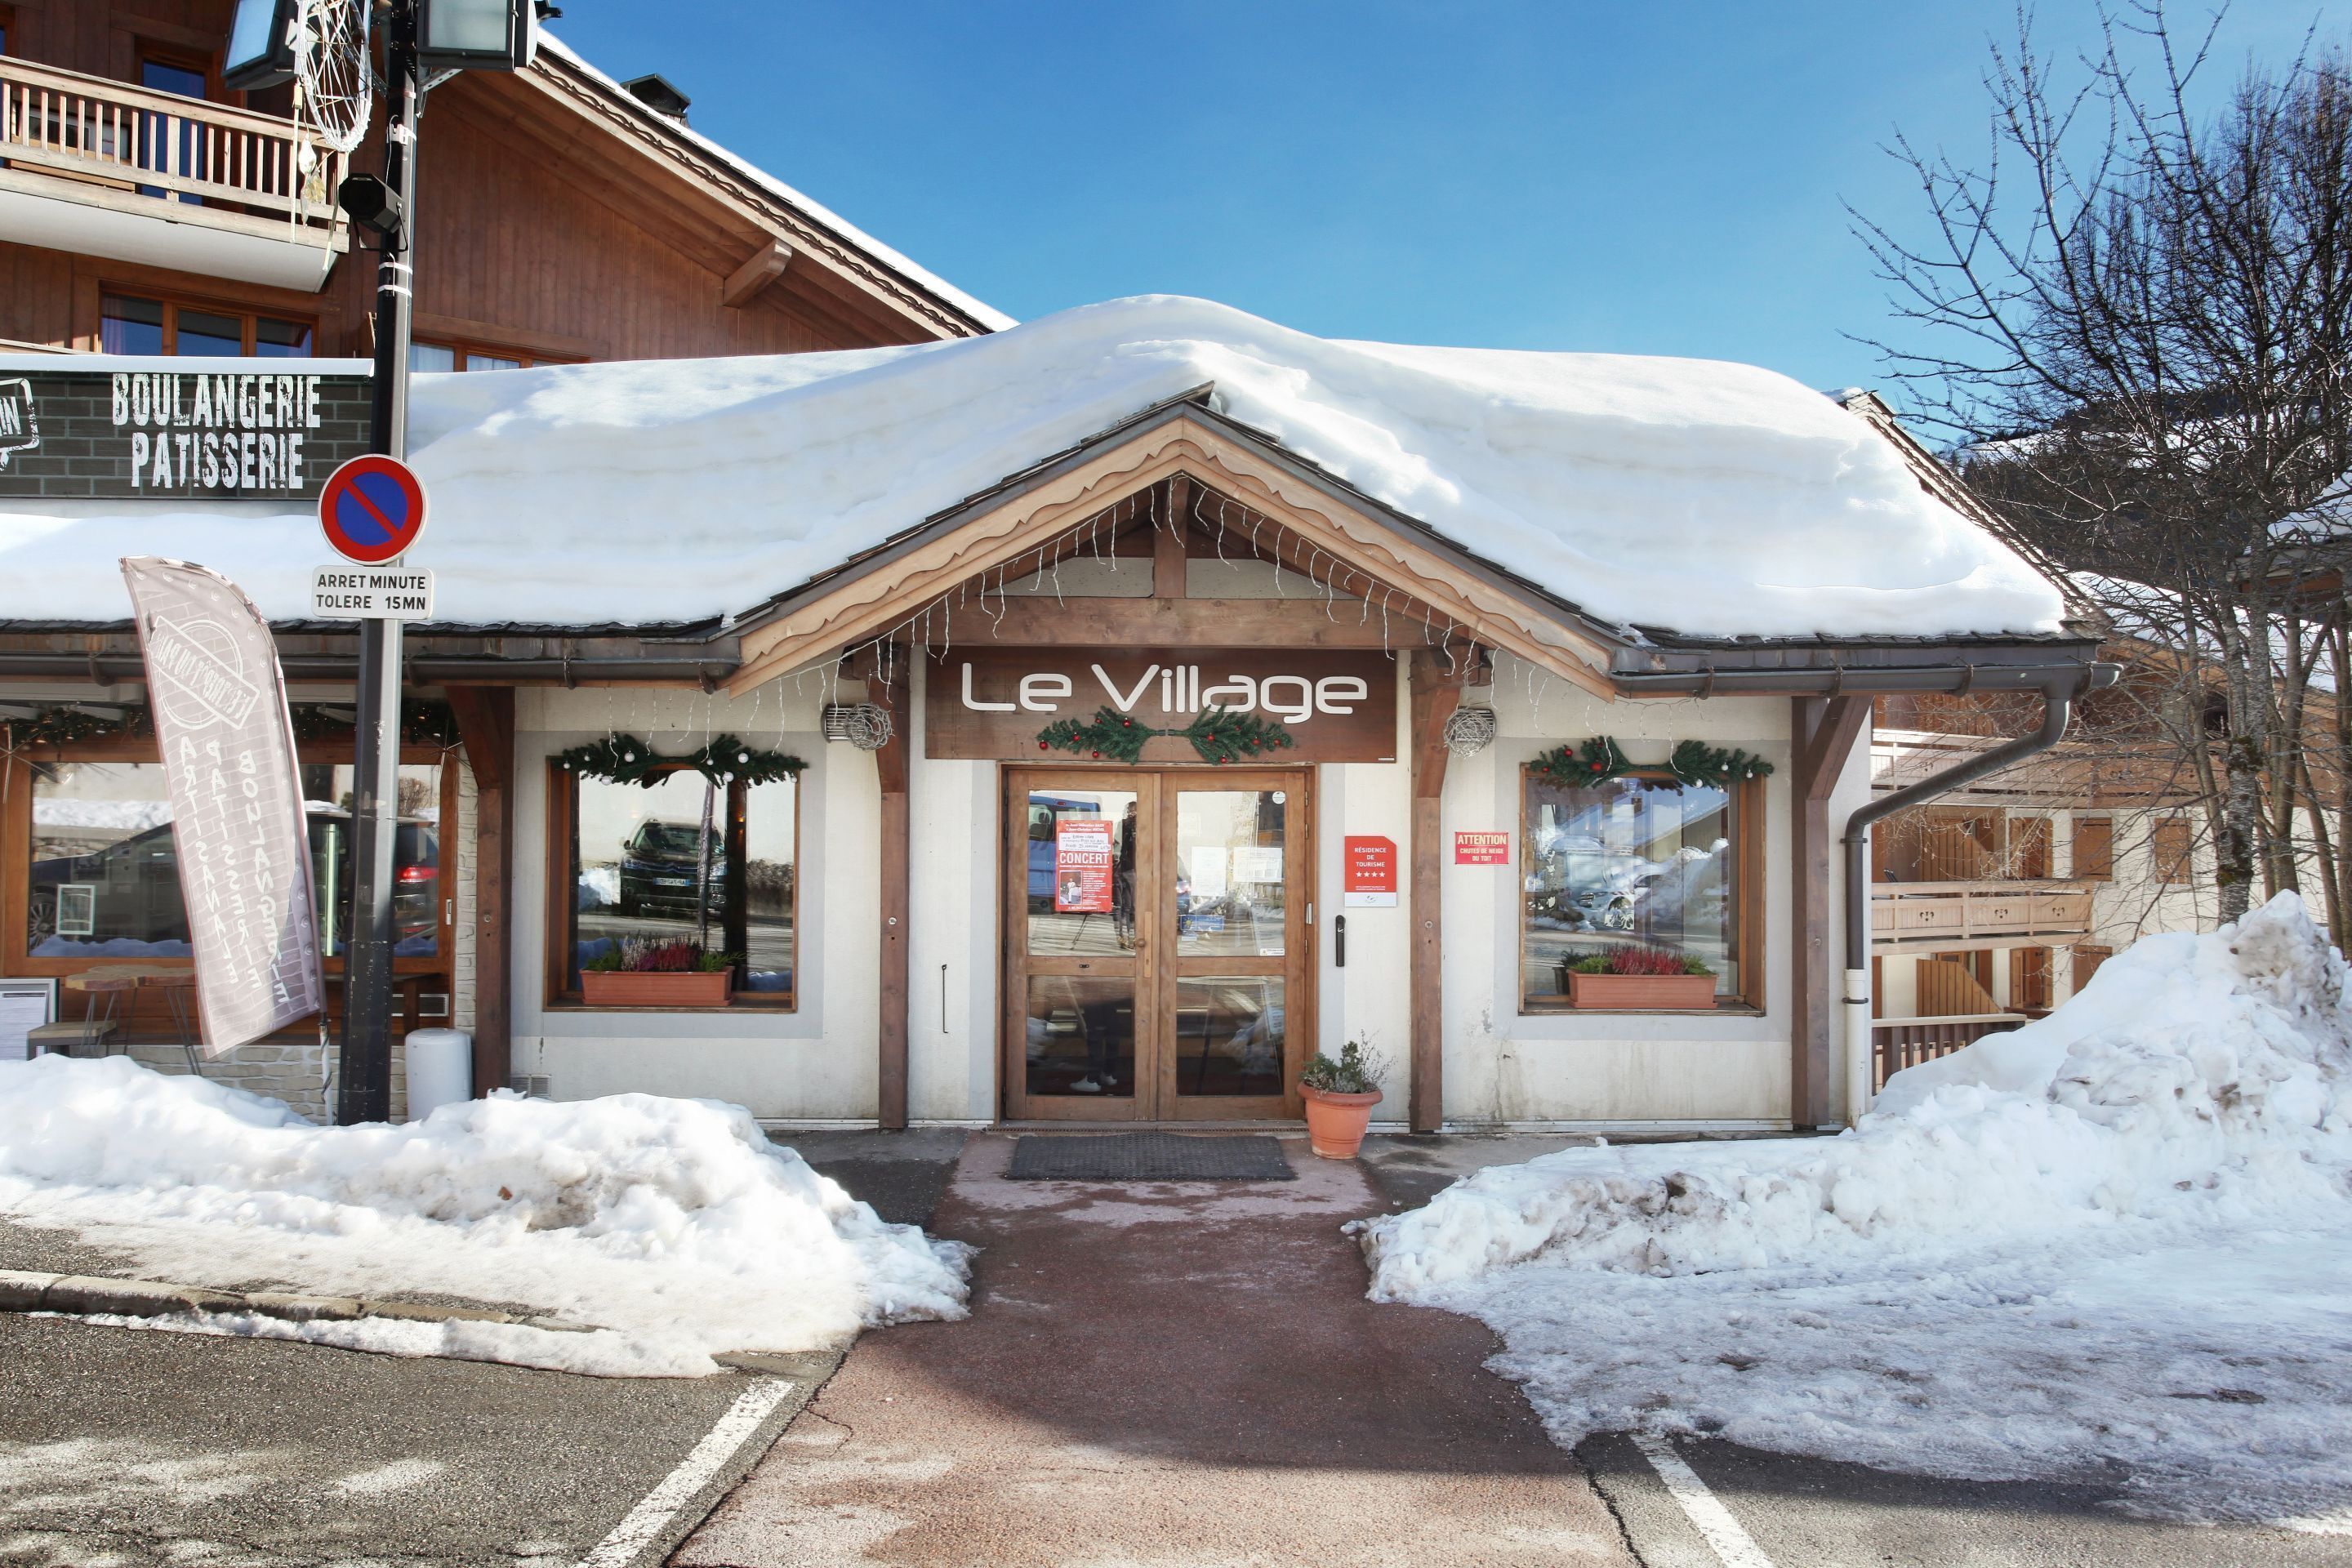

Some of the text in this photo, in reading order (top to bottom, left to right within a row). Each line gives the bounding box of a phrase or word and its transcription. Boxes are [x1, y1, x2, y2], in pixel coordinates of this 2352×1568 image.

[112, 372, 321, 429] BOULANGERIE
[131, 431, 304, 490] PATISSERIE
[317, 574, 426, 590] ARRET MINUTE
[316, 595, 372, 608] TOLERE
[961, 662, 1368, 724] Le Village
[1457, 834, 1507, 845] ATTENTION
[1059, 852, 1109, 864] CONCERT
